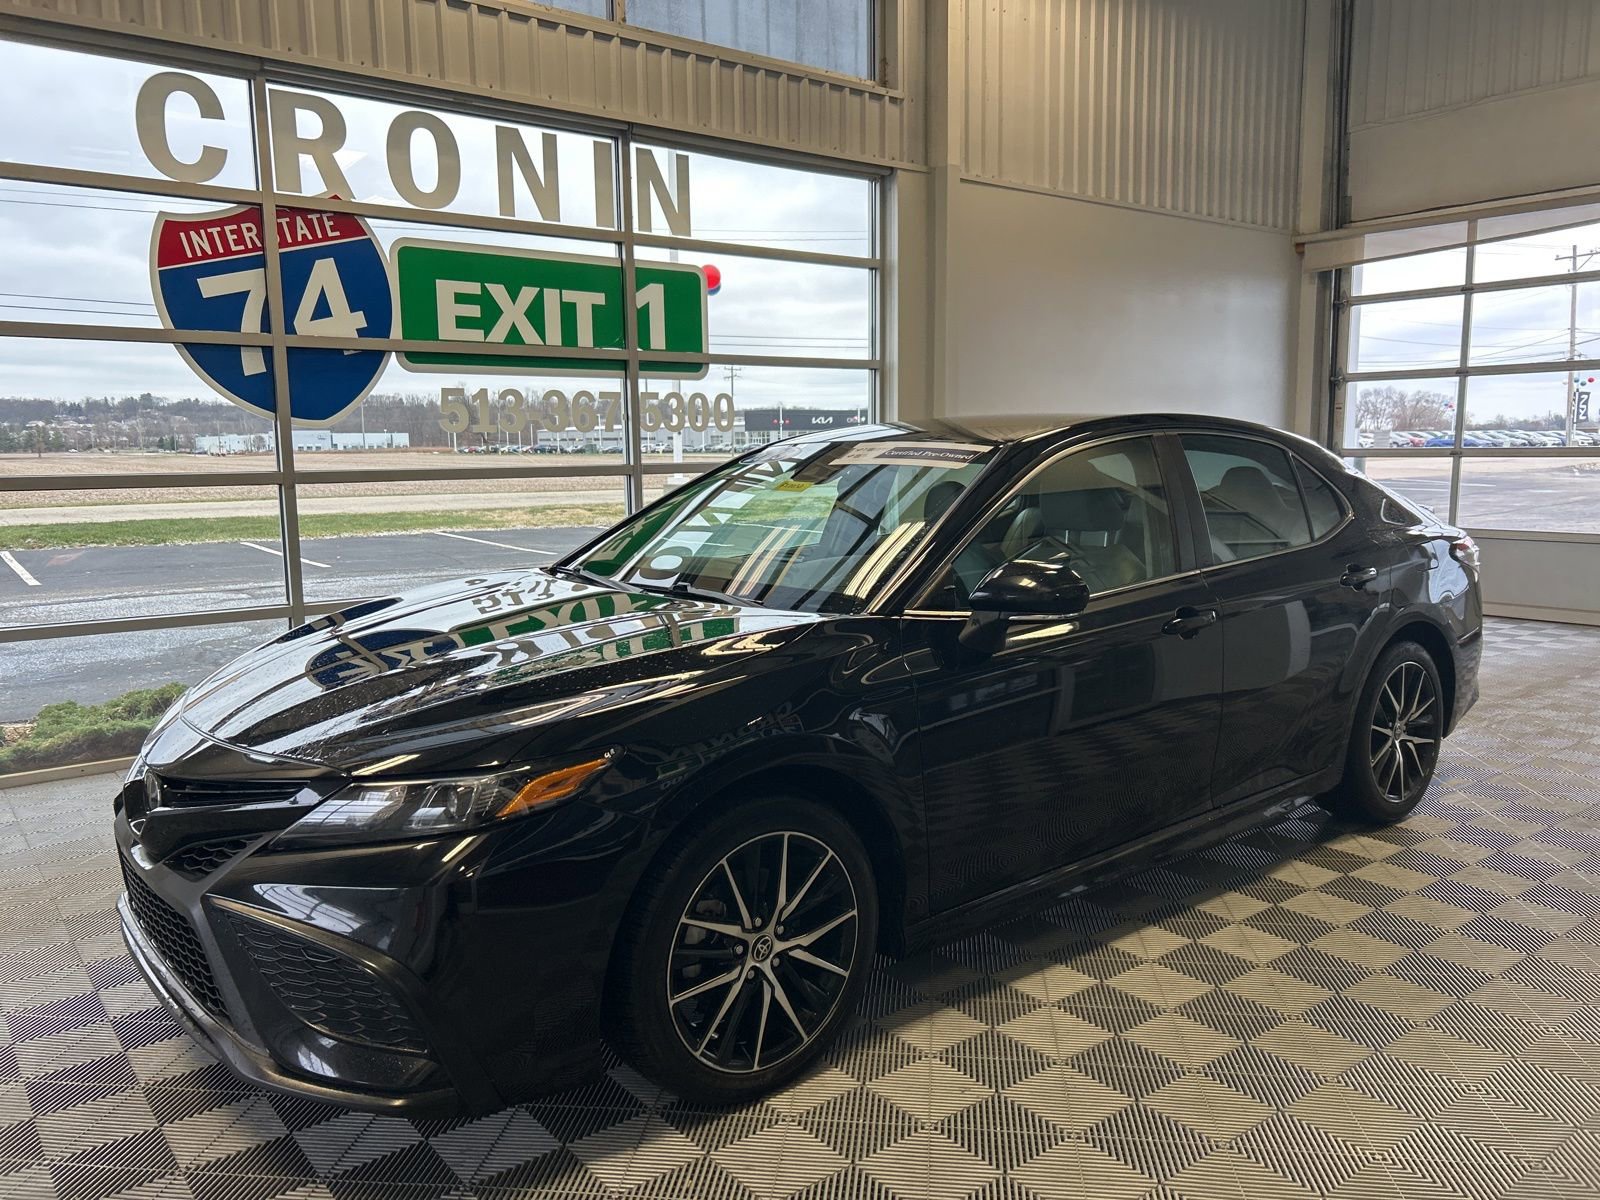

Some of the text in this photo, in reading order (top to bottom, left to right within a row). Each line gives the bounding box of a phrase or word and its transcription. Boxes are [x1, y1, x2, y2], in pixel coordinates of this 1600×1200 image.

[135, 71, 692, 237] CRONIN
[179, 213, 341, 258] INTERTATE
[197, 257, 368, 377] 74
[435, 278, 667, 351] EXIT 1
[439, 387, 735, 434] 513-3675300
[811, 416, 834, 425] KIA
[884, 449, 922, 457] Certified
[922, 450, 975, 461] Pre-Owned
